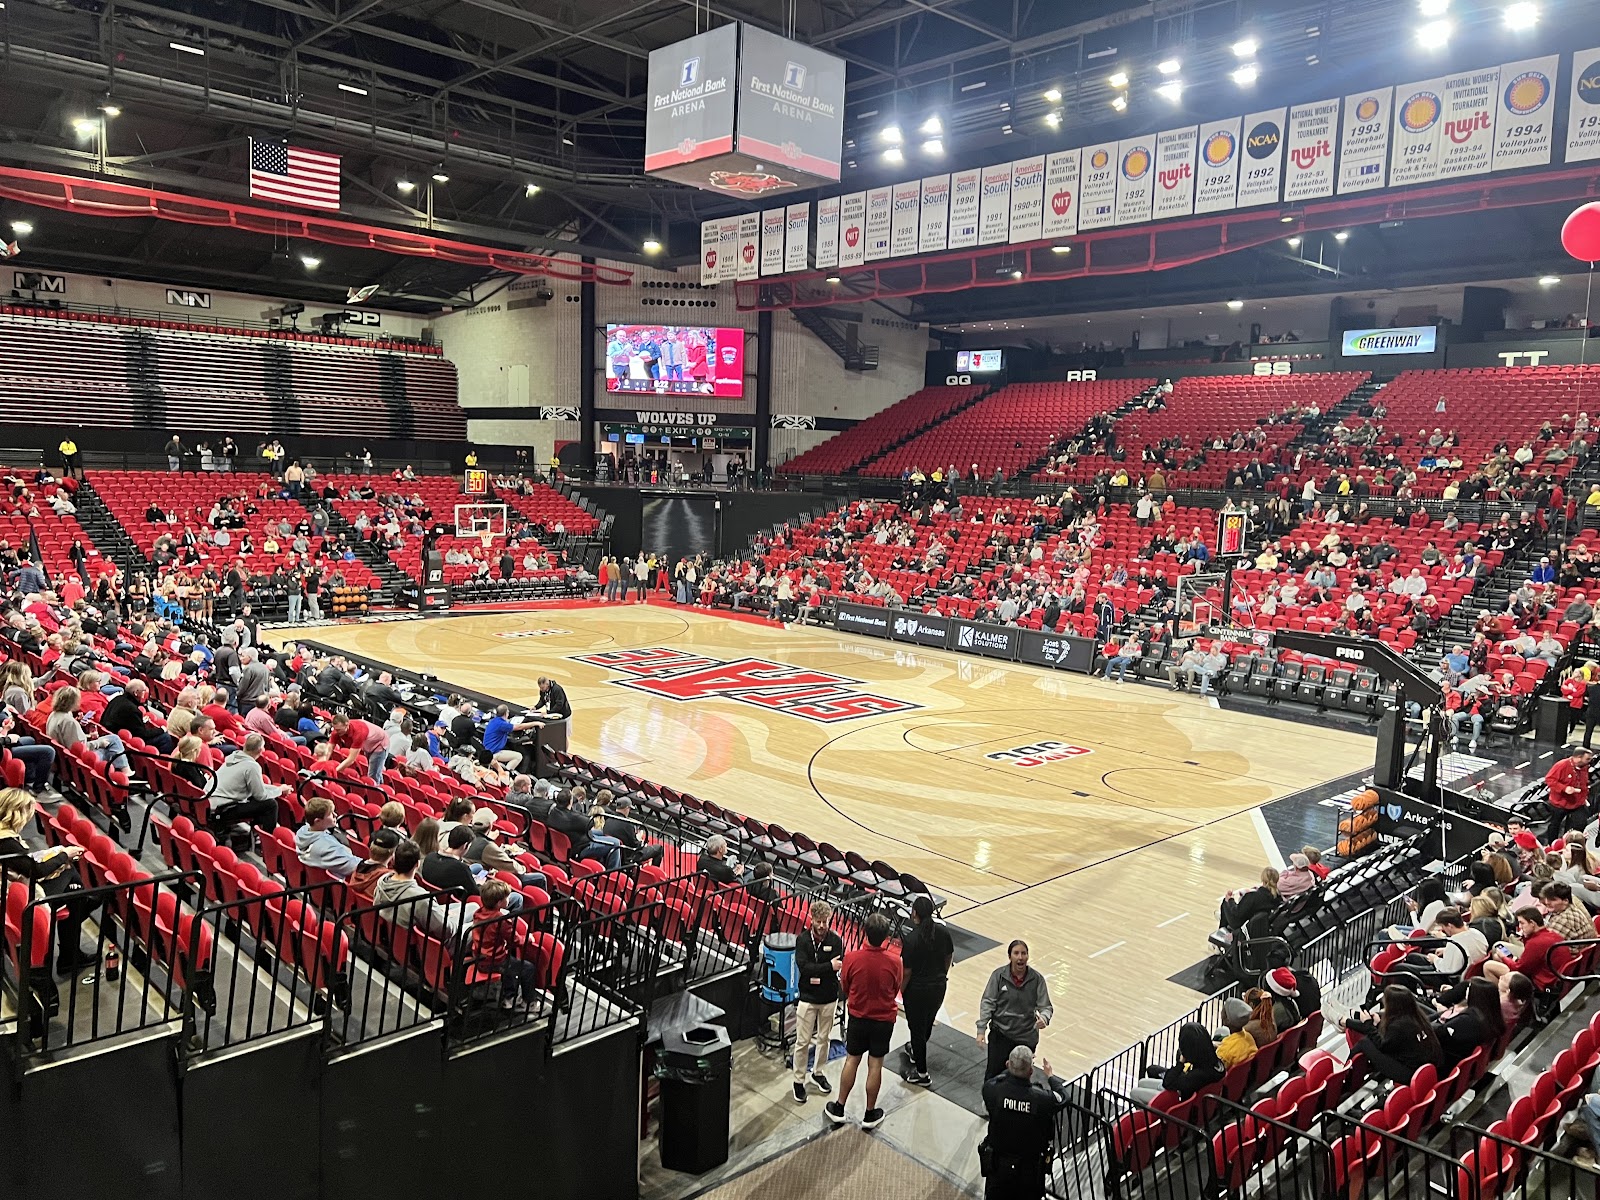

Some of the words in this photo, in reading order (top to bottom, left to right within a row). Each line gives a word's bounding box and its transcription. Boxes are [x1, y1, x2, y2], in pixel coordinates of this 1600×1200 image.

[1446, 78, 1471, 90] NATIONAL
[1472, 71, 1499, 84] WOMEN'S
[1512, 72, 1527, 85] SUN
[1528, 71, 1544, 80] BELT
[1579, 78, 1600, 91] NC
[654, 94, 670, 108] First
[671, 84, 704, 102] National
[706, 77, 727, 93] Bank
[750, 76, 771, 92] First
[772, 83, 810, 106] National
[812, 98, 835, 115] Bank
[1453, 86, 1488, 100] INVITATIONAL
[671, 99, 706, 118] ARENA
[1452, 97, 1489, 112] TOURNAMENT
[773, 101, 813, 123] ARENA
[1291, 108, 1314, 120] NATIONAL
[1314, 104, 1338, 115] WOMEN'S
[1297, 116, 1329, 129] INVITATIONAL
[1444, 111, 1492, 143] nwit
[1579, 116, 1600, 128] 19
[1297, 127, 1329, 139] TOURNAMENT
[1351, 123, 1381, 137] 1993
[1506, 123, 1543, 137] 1994
[1159, 135, 1177, 145] NATIONAL
[1177, 131, 1197, 142] WOMEN'S
[1247, 134, 1278, 148] NCAA
[1346, 133, 1385, 146] Volleyball
[1500, 135, 1547, 149] Volleyball
[1163, 142, 1189, 152] INVITATIONAL
[1343, 143, 1385, 156] Champions
[1403, 143, 1432, 156] 1994
[1449, 144, 1483, 156] 1993-94
[1496, 144, 1548, 157] Champions
[1163, 151, 1189, 162] TOURNAMENT
[1290, 139, 1332, 168] nwit
[1444, 152, 1487, 165] Basketball
[1052, 156, 1075, 166] NATIONAL
[1405, 156, 1427, 164] Men's
[1014, 163, 1043, 174] American
[1050, 165, 1076, 176] INVITATION
[1247, 167, 1275, 180] 1992
[1392, 165, 1413, 175] Track
[1440, 161, 1488, 174] RUNNER-UP
[984, 172, 1010, 182] American
[1014, 172, 1042, 188] South
[1047, 174, 1078, 186] TOURNAMENT
[1087, 171, 1111, 182] 1991
[1158, 163, 1192, 189] nwit
[1204, 175, 1231, 187] 1992
[1295, 170, 1325, 180] 1992-93
[1395, 171, 1436, 182] Champions
[956, 182, 976, 192] South
[983, 181, 1009, 195] South
[1083, 180, 1114, 190] Volleyball
[1246, 179, 1274, 189] Volleyball
[1291, 178, 1328, 188] Basketball
[1342, 176, 1380, 188] Volleyball
[896, 190, 919, 200] American
[924, 184, 948, 194] American
[1082, 188, 1115, 198] Champions
[1124, 189, 1145, 200] 1992
[1199, 185, 1233, 196] Volleyball
[1240, 185, 1278, 197] Championship
[1288, 186, 1329, 197] CHAMPIONS
[871, 198, 888, 208] South
[923, 192, 948, 205] South
[955, 195, 975, 206] 1990
[1054, 196, 1070, 208] NIT
[1123, 200, 1146, 208] Women's
[1197, 193, 1235, 203] Champions
[894, 198, 918, 211] South
[1014, 199, 1041, 211] 1990-91
[1158, 202, 1189, 212] Basketball
[986, 212, 1003, 222] 1991
[1012, 211, 1040, 221] BASKETBALL
[1117, 207, 1131, 216] Track
[1119, 212, 1148, 221] Champions
[788, 219, 808, 230] South
[819, 214, 838, 225] South
[1082, 216, 1111, 226] Volleyball
[763, 223, 783, 235] South
[1012, 221, 1040, 231] CHAMPIONS
[719, 231, 738, 242] South
[847, 230, 859, 242] NIT
[744, 248, 754, 258] NIT
[168, 290, 210, 308] NN
[345, 310, 380, 325] PP
[1358, 334, 1421, 350] GREENWAY
[1498, 350, 1549, 367] TT
[1253, 361, 1292, 376] SS
[1067, 370, 1097, 382] RR
[636, 411, 694, 424] WOLVES
[697, 412, 717, 426] UP
[665, 427, 688, 435] EXIT
[917, 624, 946, 637] Arkansas
[1209, 626, 1251, 639] CENTENNIAL
[974, 631, 1009, 644] KALMER
[1044, 639, 1060, 648] Lost
[1220, 634, 1239, 643] BANK
[974, 639, 1007, 650] SOLUTIONS
[1042, 646, 1060, 655] Pizza
[1044, 653, 1055, 661] Co.
[1336, 646, 1365, 660] PRO
[1003, 1097, 1031, 1113] POLICE
